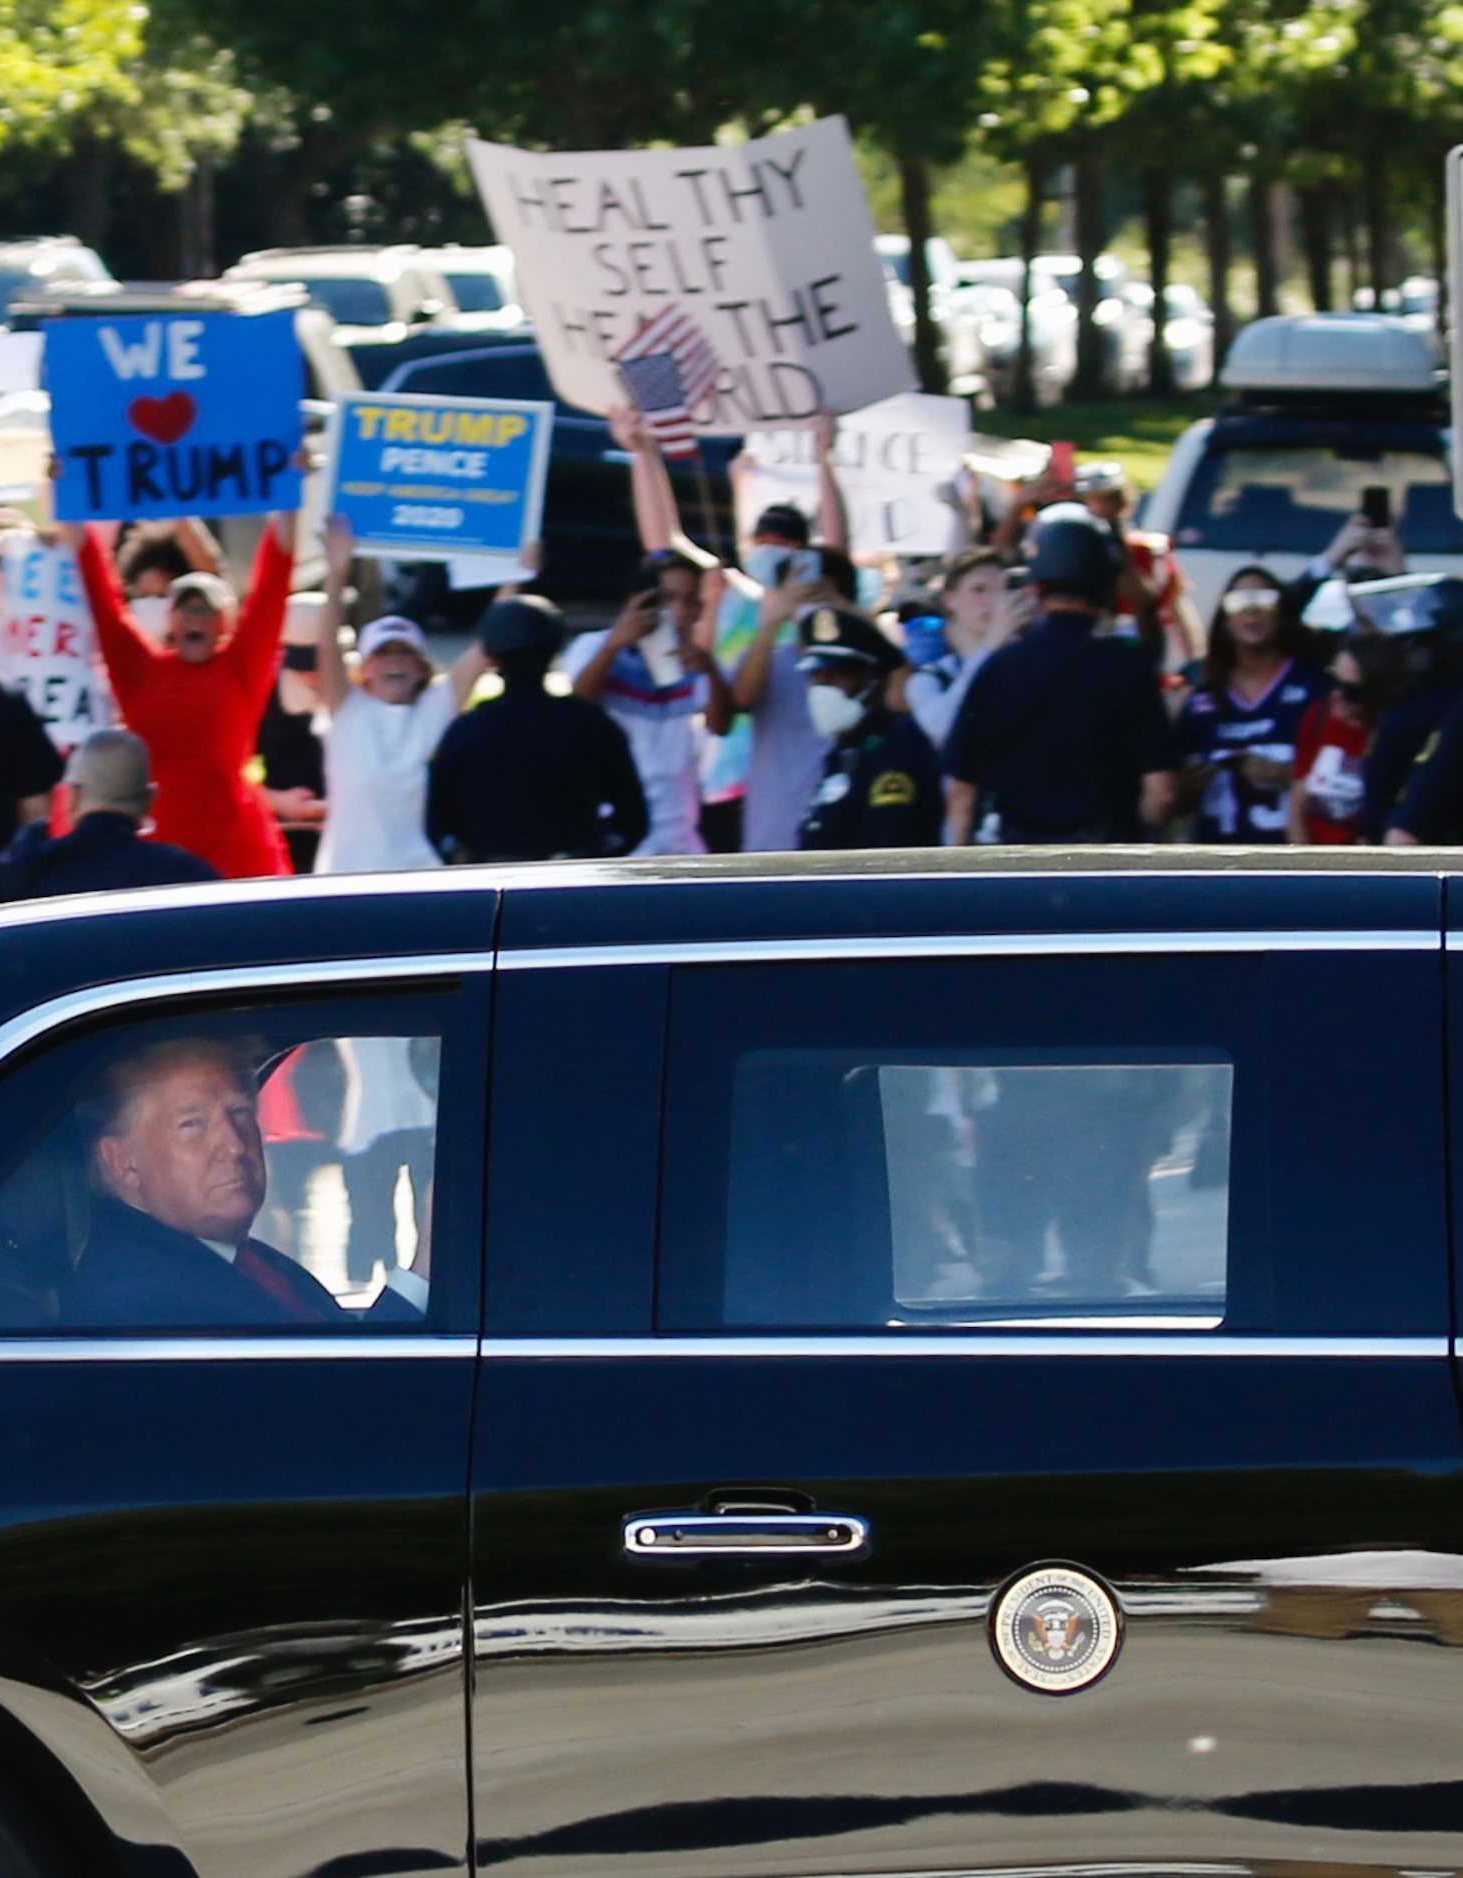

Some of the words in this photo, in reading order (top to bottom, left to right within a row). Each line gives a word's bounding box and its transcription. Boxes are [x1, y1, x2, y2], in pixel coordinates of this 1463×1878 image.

[505, 147, 807, 233] HEALTHY
[593, 236, 729, 296] SELF
[716, 274, 859, 357] THE
[97, 320, 207, 380] WE
[355, 407, 528, 448] TRUMP
[69, 438, 288, 511] TRUMP
[380, 447, 489, 478] PENCE
